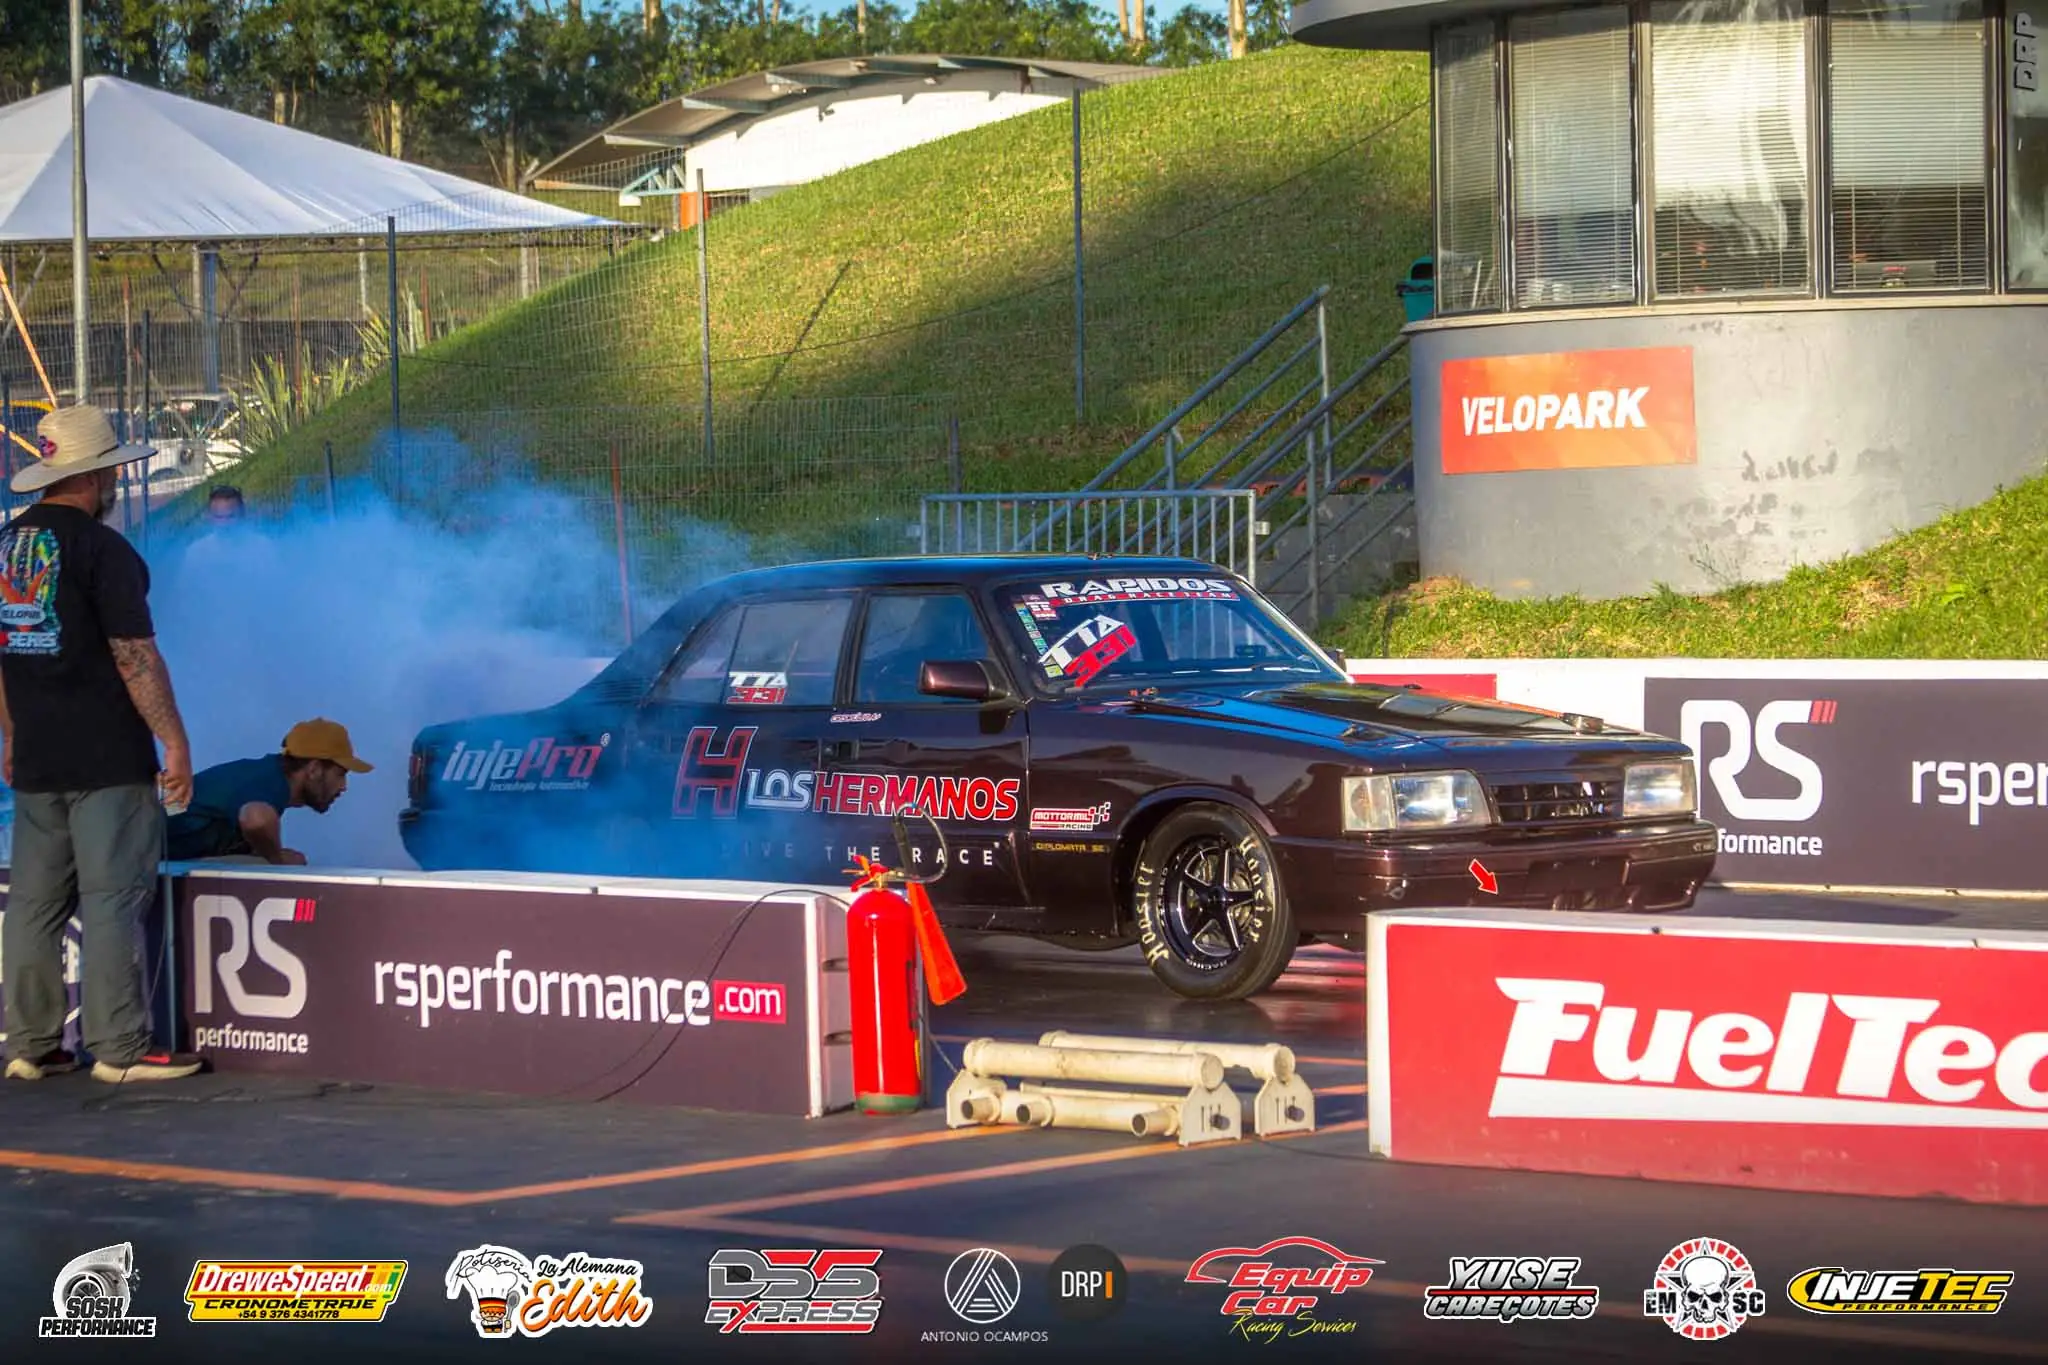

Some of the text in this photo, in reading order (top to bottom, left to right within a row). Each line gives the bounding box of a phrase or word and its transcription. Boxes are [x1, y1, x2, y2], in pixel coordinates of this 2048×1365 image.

[1462, 386, 1649, 437] VELOPARK
[1040, 578, 1232, 598] RAPIDOS
[728, 671, 788, 687] TTA
[1681, 700, 1824, 821] RS
[824, 845, 881, 862] THE
[1717, 828, 1823, 855] formance
[193, 894, 307, 1019] RS
[195, 1023, 309, 1054] performance
